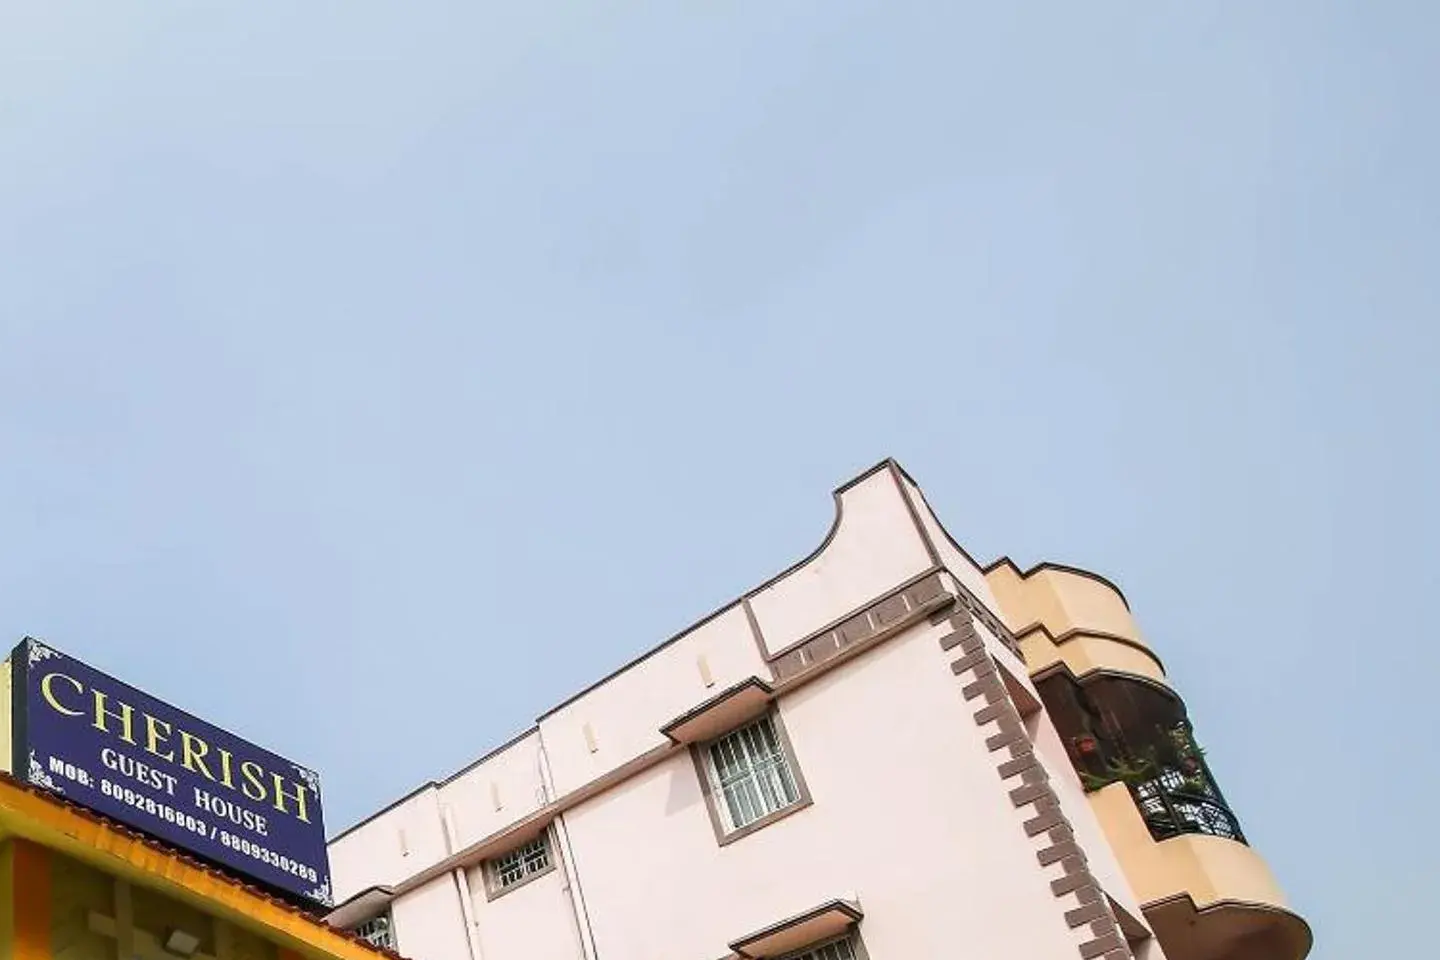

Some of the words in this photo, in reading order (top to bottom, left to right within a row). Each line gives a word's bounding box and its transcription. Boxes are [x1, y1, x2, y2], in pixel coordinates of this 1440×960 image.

[40, 672, 312, 824] CHERISH
[49, 756, 95, 789] MOB:
[101, 748, 178, 796] GUEST
[193, 786, 268, 836] HOUSE
